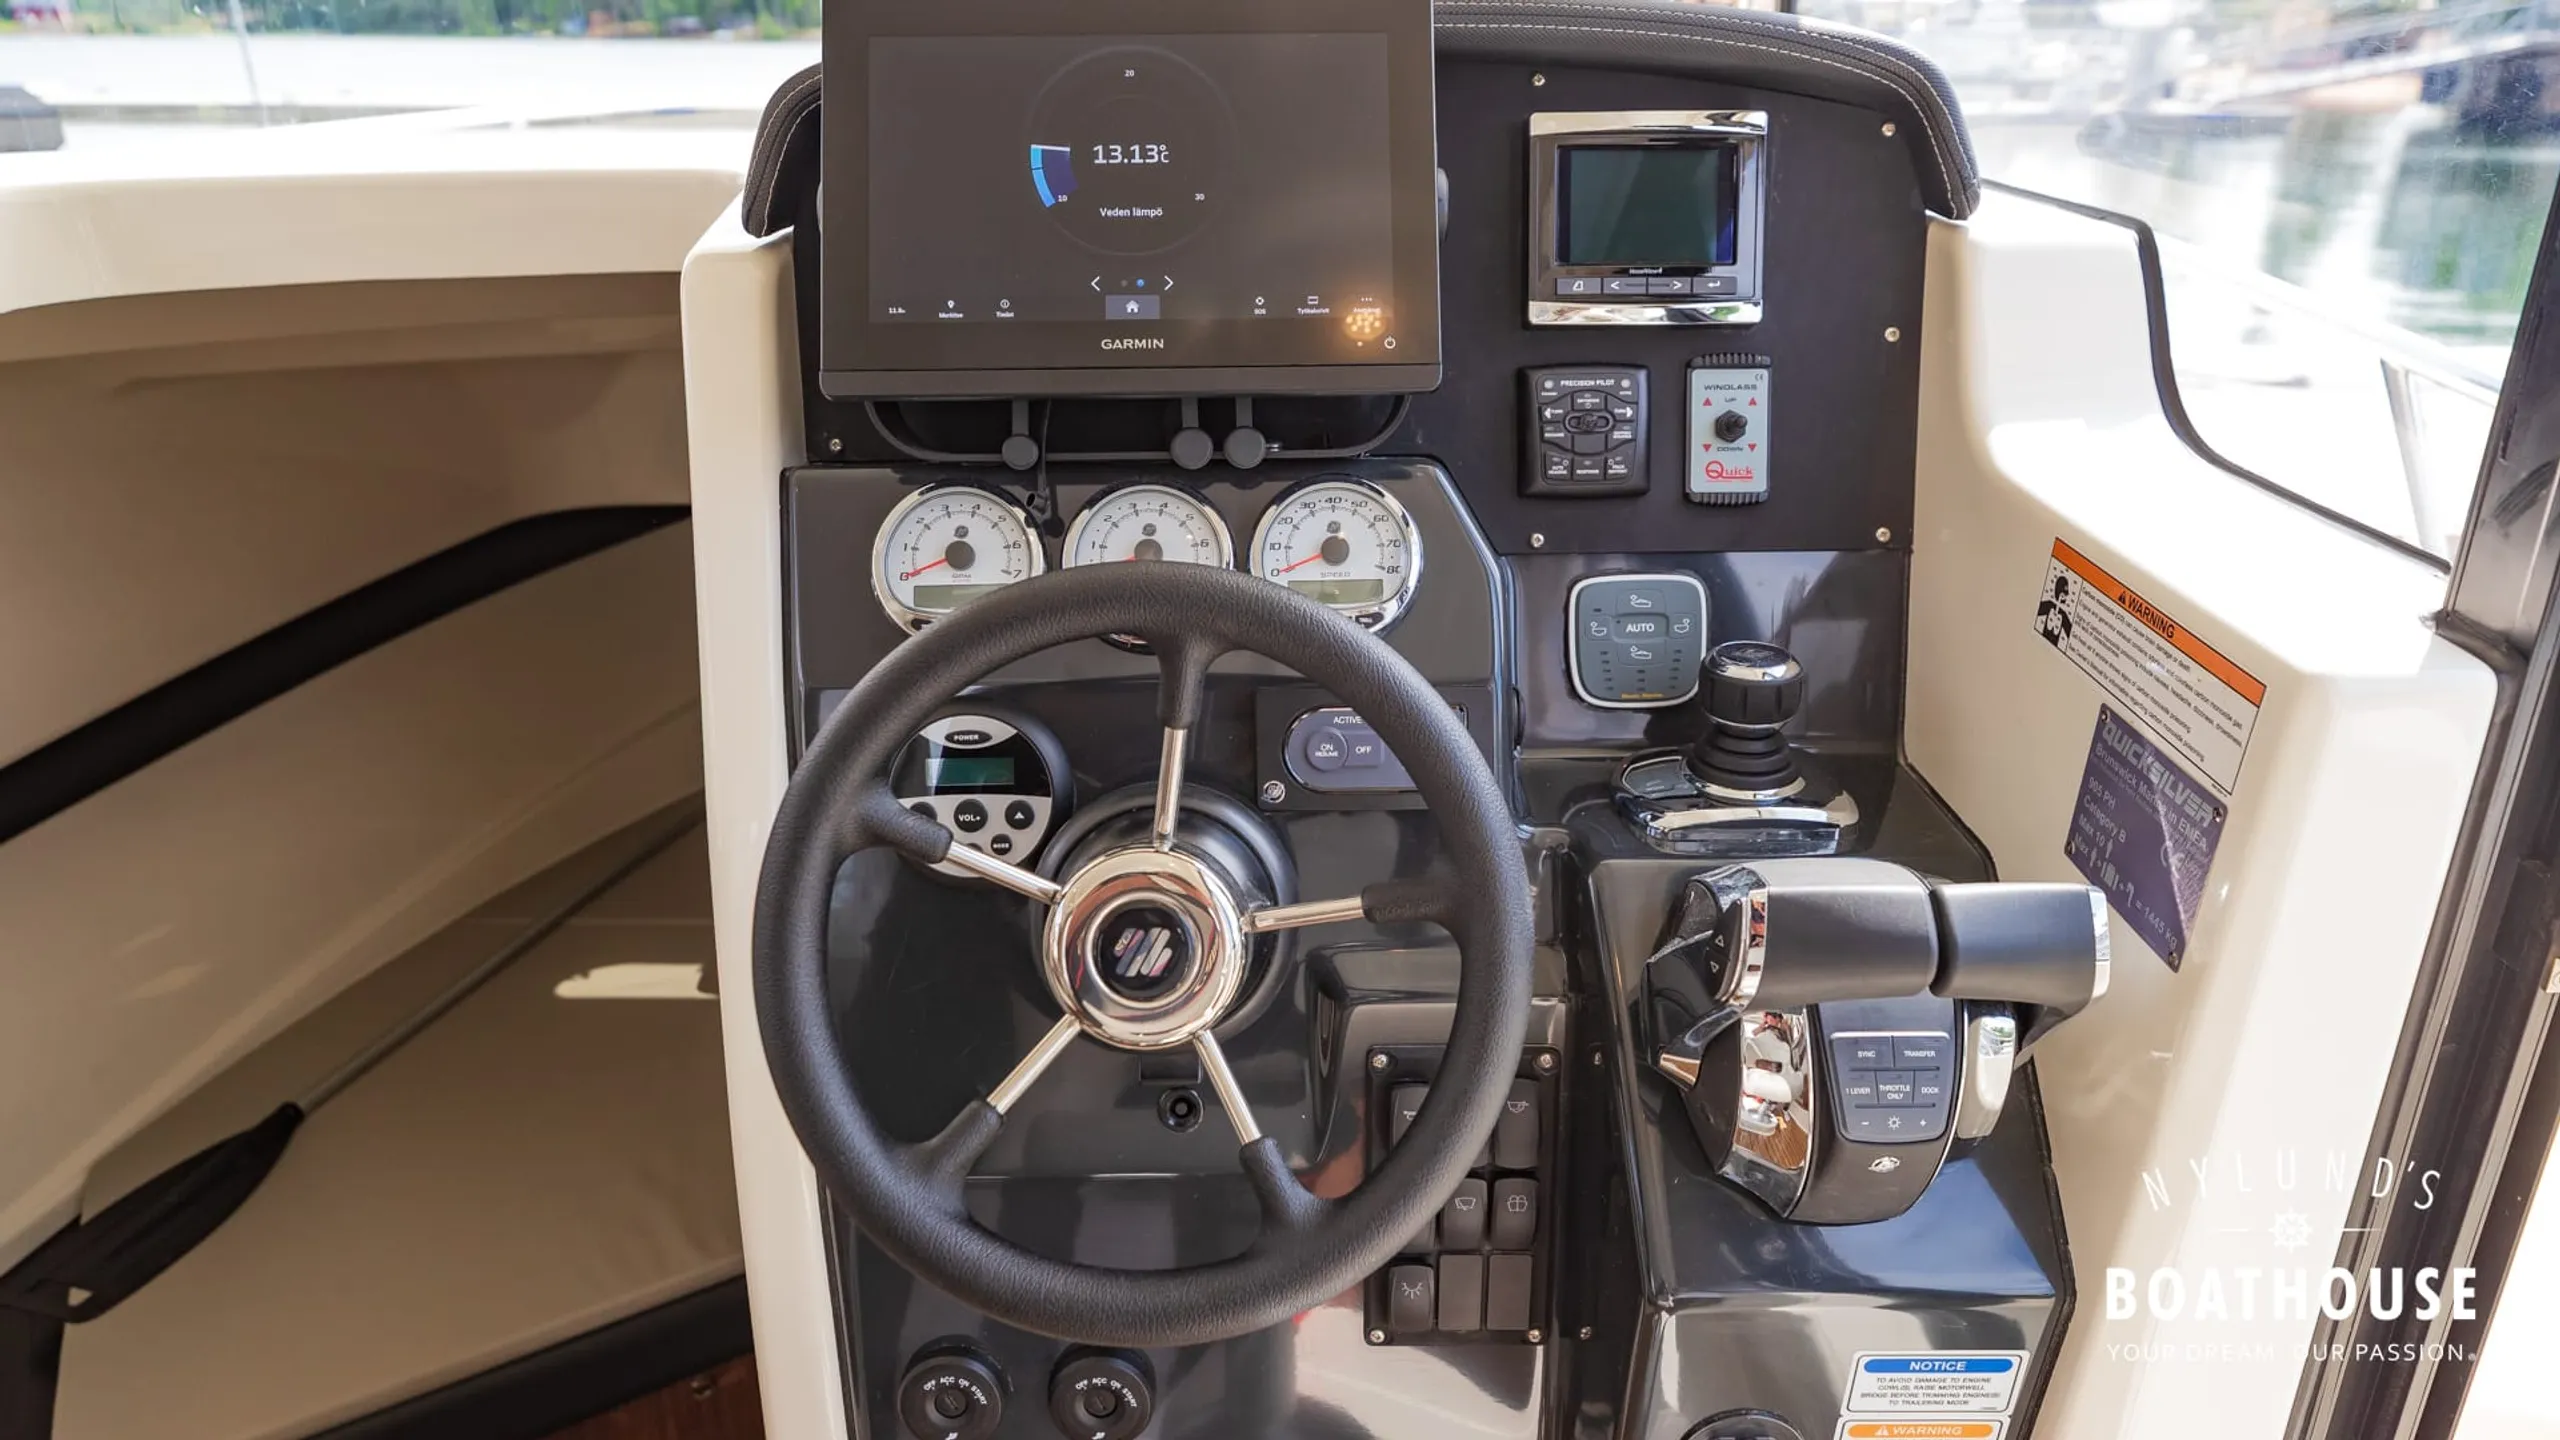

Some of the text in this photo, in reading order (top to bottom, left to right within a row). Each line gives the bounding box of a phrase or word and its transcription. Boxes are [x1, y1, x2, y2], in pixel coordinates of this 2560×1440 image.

[1195, 193, 1205, 201] 30
[1100, 207, 1163, 218] Veden lämpö
[1101, 338, 1164, 350] GARMIN
[1278, 516, 1294, 524] 20
[1269, 543, 1281, 551] 10
[1387, 539, 1401, 548] 70
[1271, 568, 1280, 577] 0
[2128, 594, 2176, 639] WARNING
[1626, 623, 1654, 633] AUTO
[1333, 716, 1363, 724] ACTIVE
[1355, 746, 1372, 754] OFF
[2102, 720, 2213, 828] QUICKSILVER
[2088, 776, 2102, 797] 905
[2102, 789, 2116, 809] PH
[2083, 794, 2117, 837] Category
[2118, 827, 2127, 843] B
[2078, 813, 2094, 837] Max
[2143, 905, 2164, 933] 1445
[1909, 1361, 1967, 1371] NOTICE
[923, 1376, 987, 1405] OFF ACC ON START
[1075, 1377, 1137, 1407] OFF ACC ON START
[1892, 1426, 1963, 1435] WARNING
